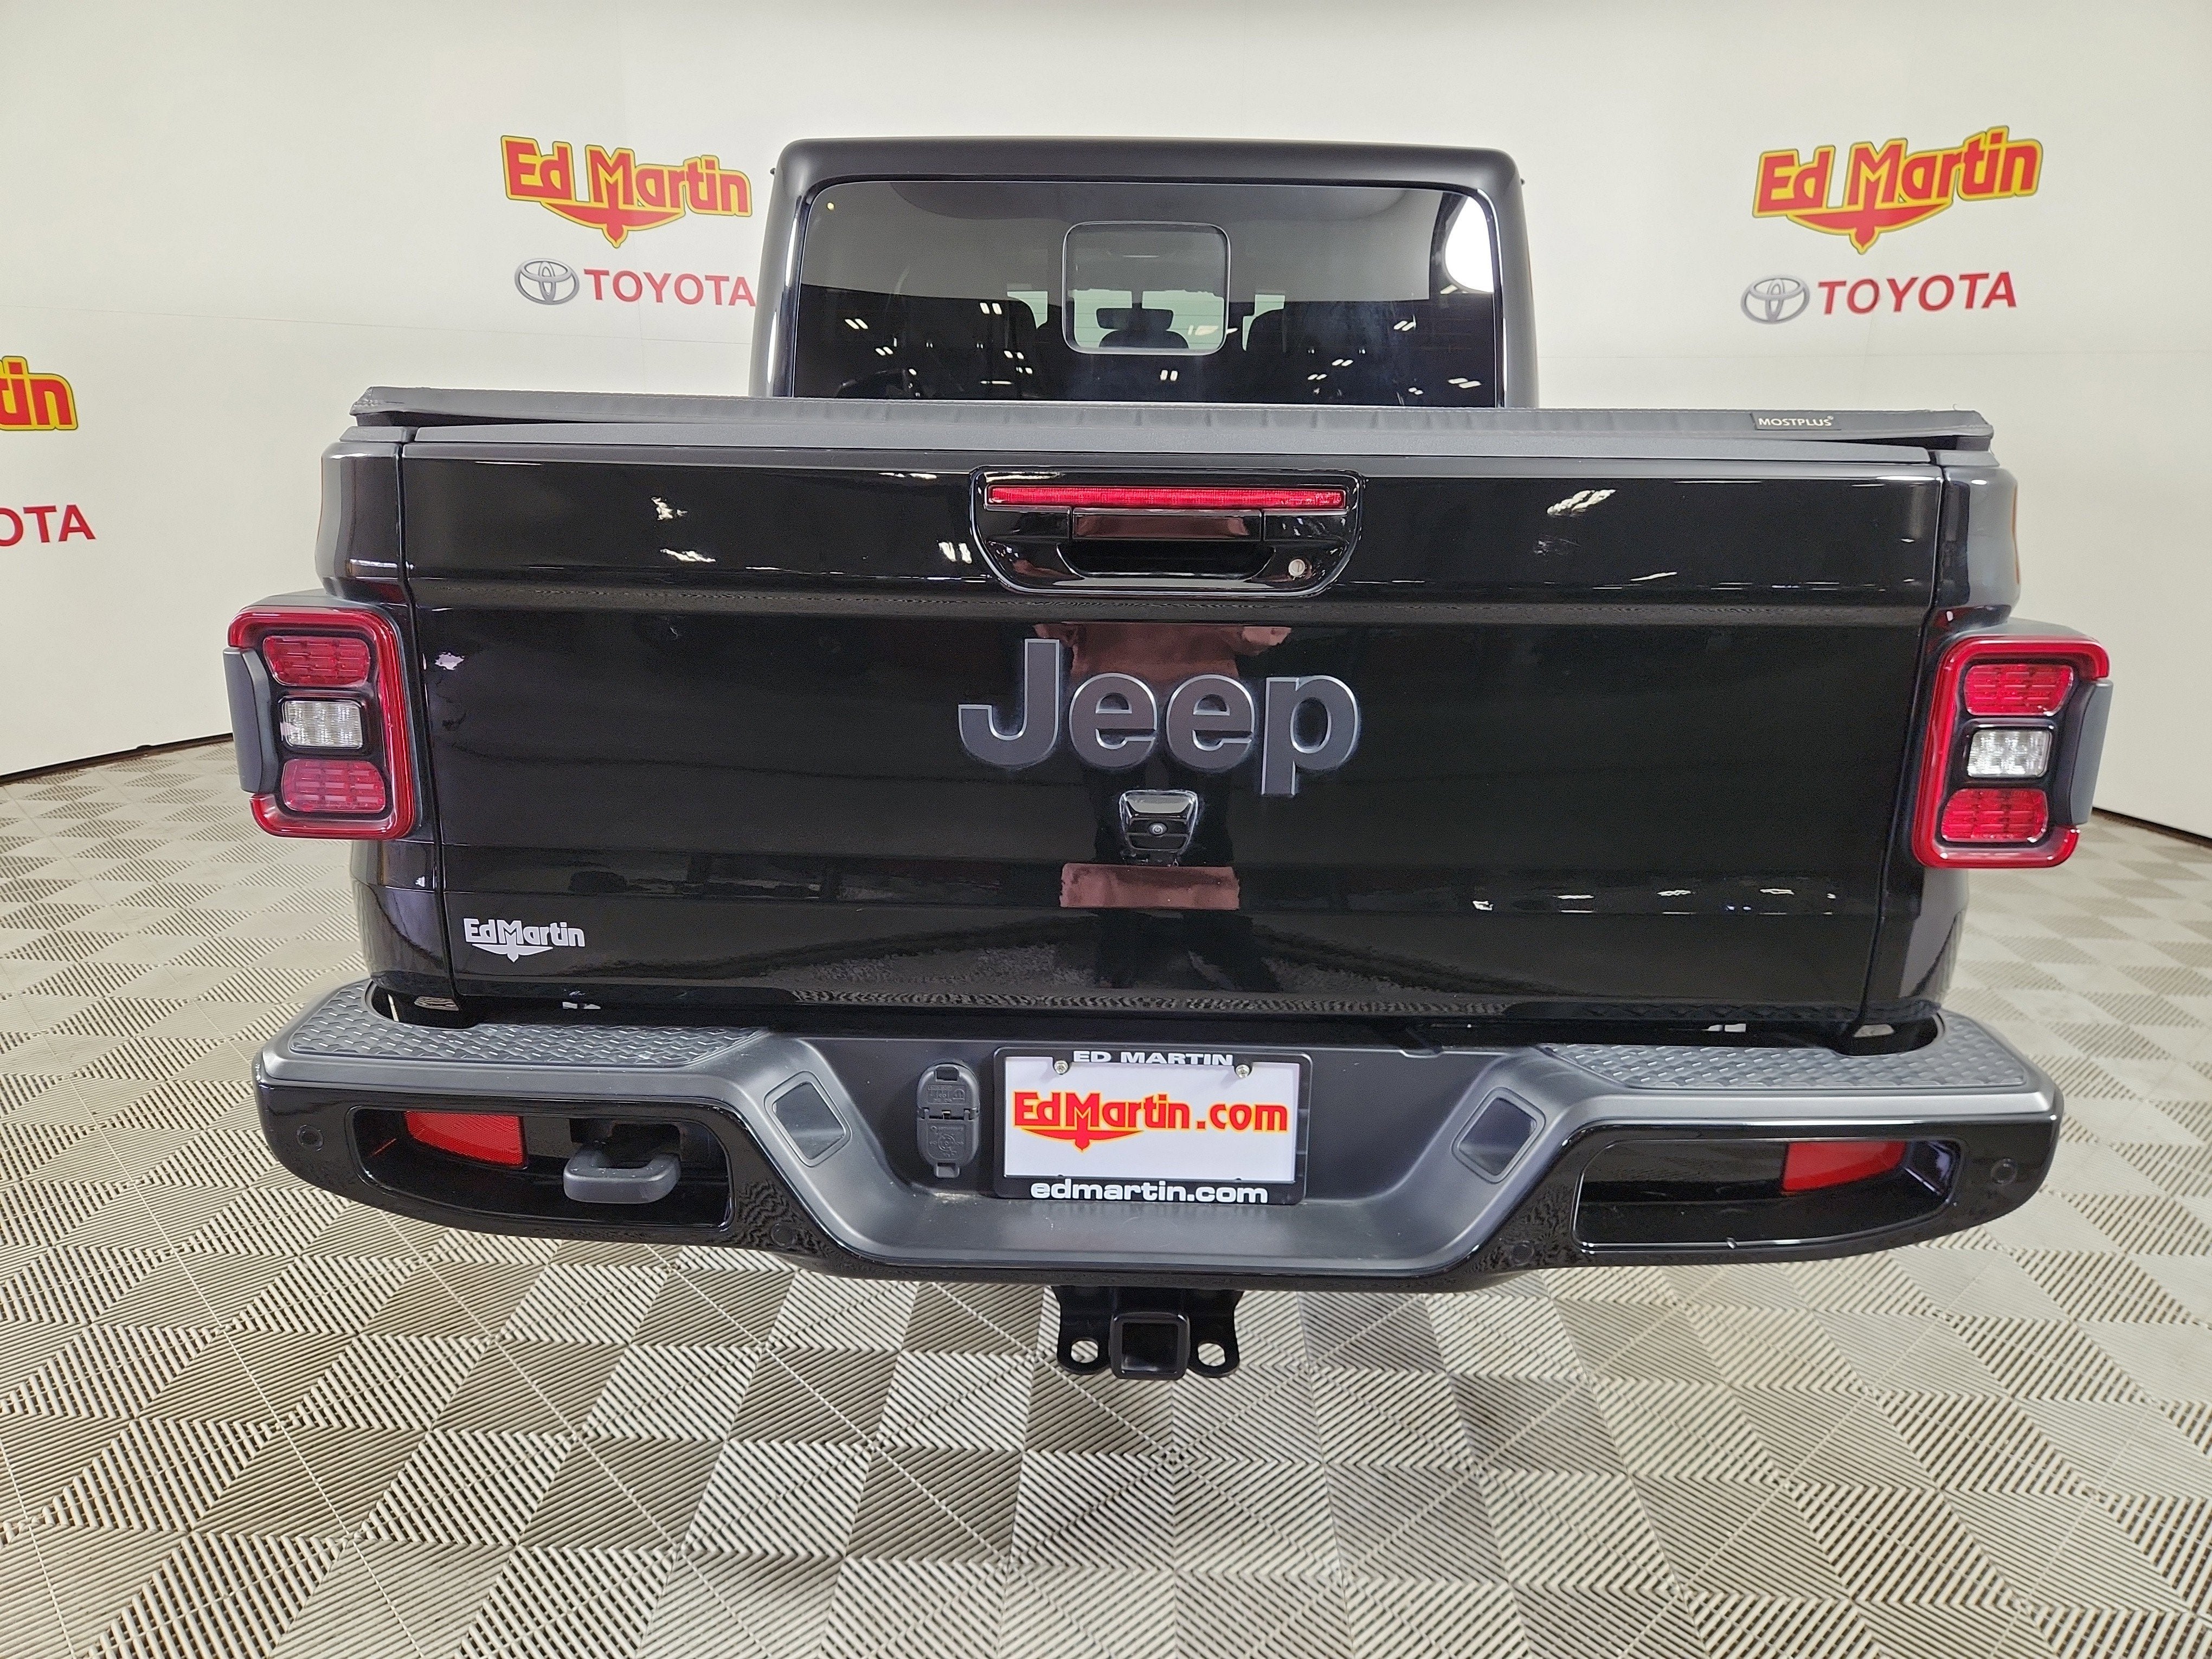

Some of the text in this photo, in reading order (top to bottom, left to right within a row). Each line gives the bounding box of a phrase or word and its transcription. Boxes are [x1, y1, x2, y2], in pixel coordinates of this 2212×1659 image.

[501, 135, 753, 217] Ed Martin
[1752, 125, 2043, 218] Ed Martin
[583, 268, 756, 307] TOYOTA
[1817, 271, 2017, 316] TOYOTA
[1758, 417, 1832, 427] MOSTPLUS
[957, 639, 1360, 797] Jeep
[1072, 1050, 1233, 1066] ED MARTIN
[1030, 1179, 1268, 1204] edmartin.com
